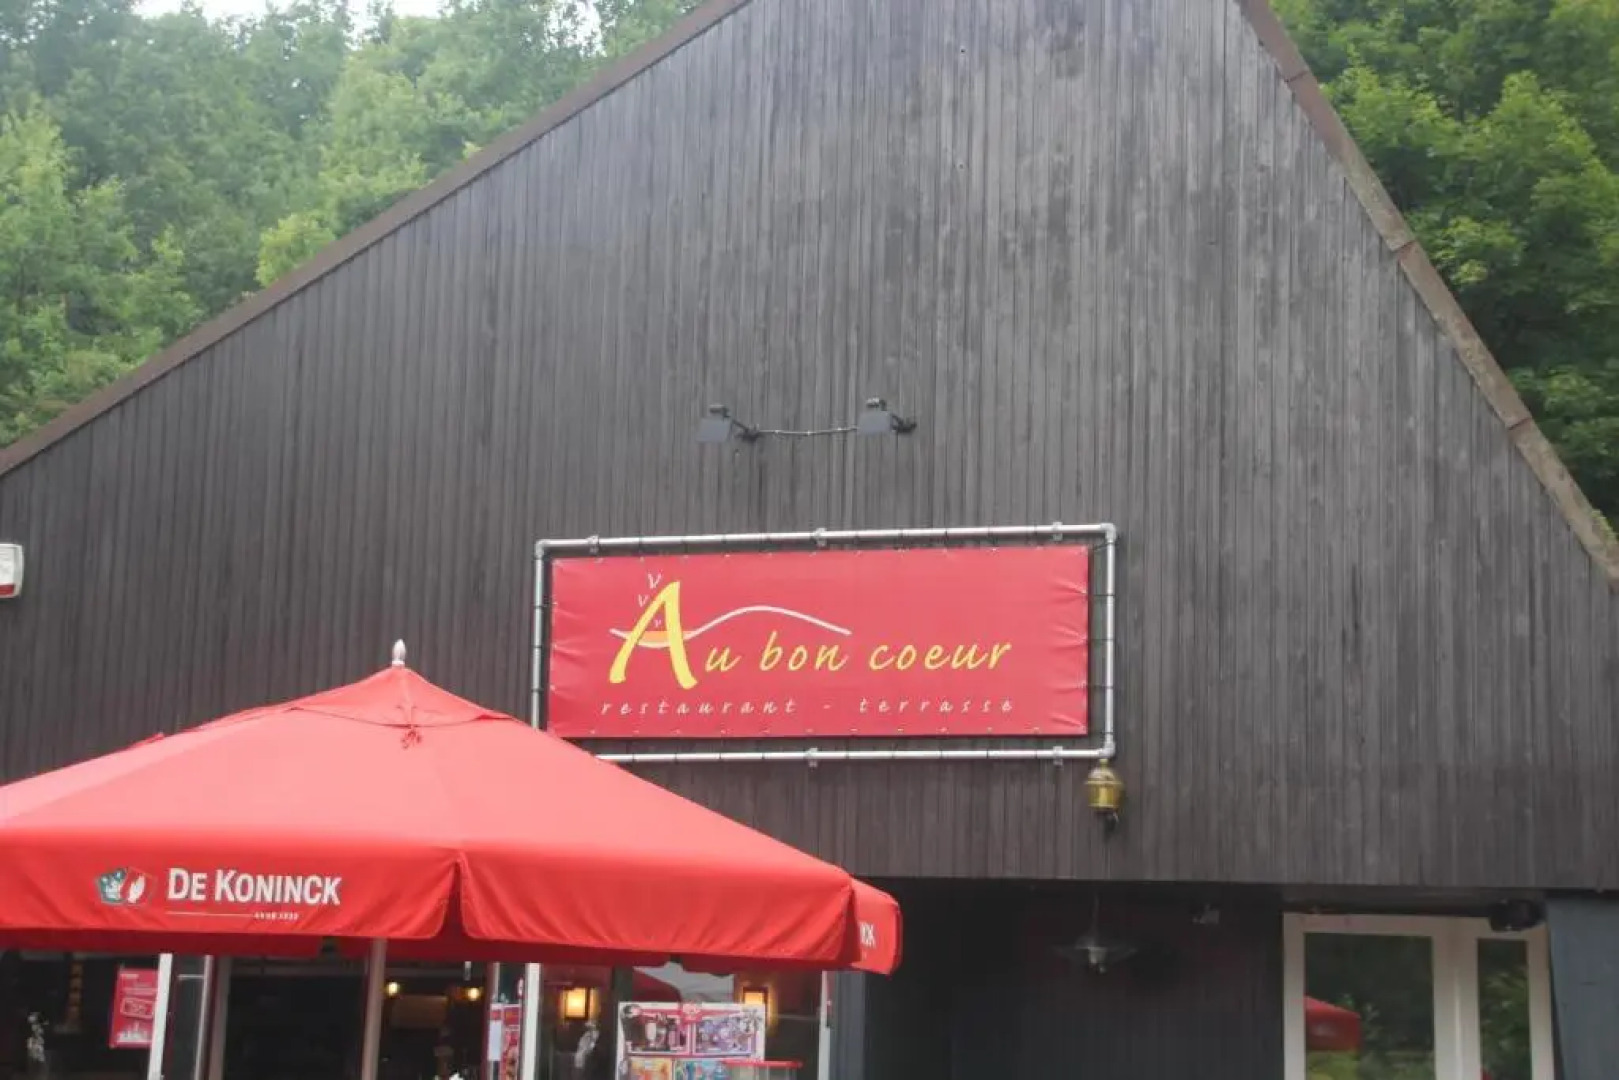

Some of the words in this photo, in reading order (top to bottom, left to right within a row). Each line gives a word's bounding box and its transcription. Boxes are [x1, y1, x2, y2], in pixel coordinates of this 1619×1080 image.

[609, 581, 742, 690] Au
[760, 631, 847, 672] bon
[869, 637, 1012, 671] coeur
[601, 698, 797, 716] restaurant
[859, 698, 1014, 714] terrasse
[168, 867, 208, 902] DE
[215, 869, 342, 906] KONINCK
